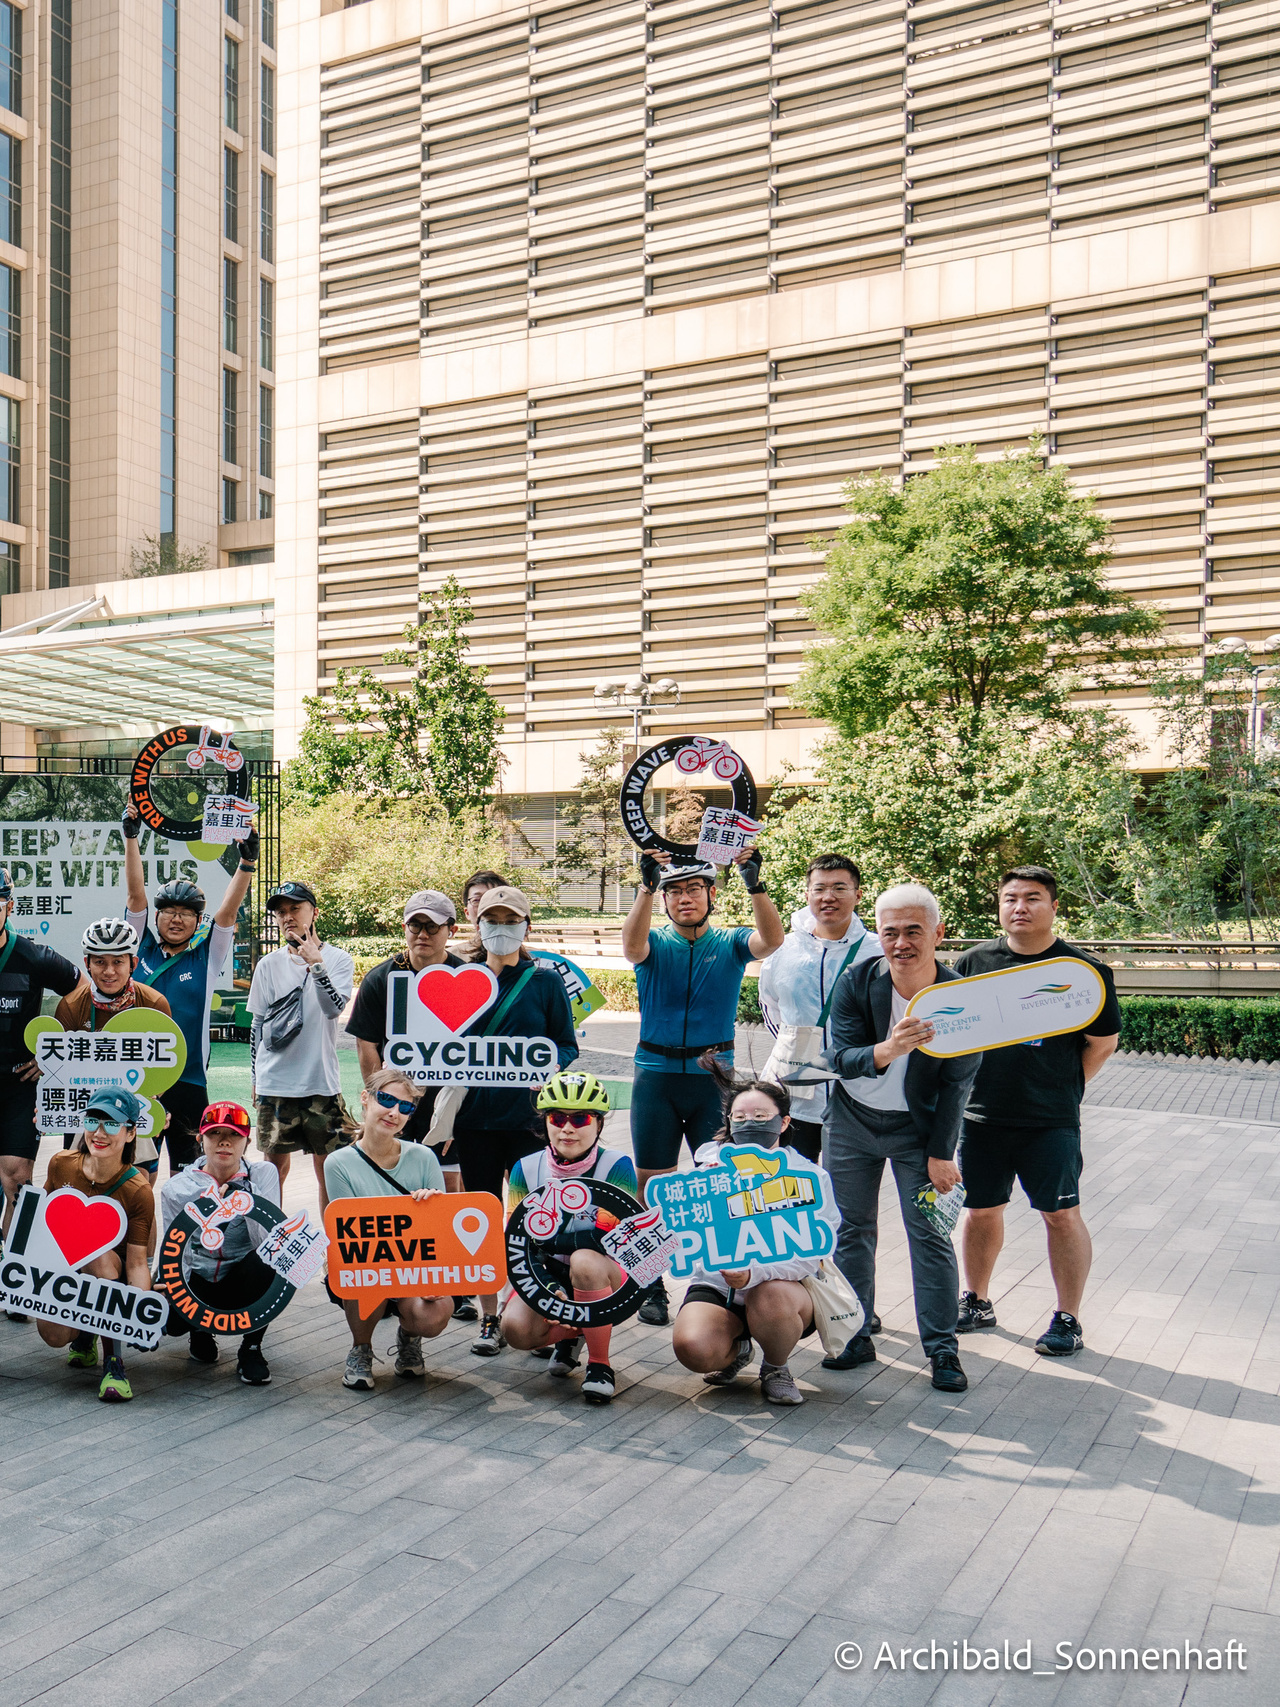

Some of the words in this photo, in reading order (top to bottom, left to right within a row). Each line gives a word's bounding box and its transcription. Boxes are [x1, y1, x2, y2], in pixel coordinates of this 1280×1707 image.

[163, 728, 188, 746] US
[133, 740, 164, 787] WITH
[626, 746, 671, 794] WAVE
[135, 790, 165, 828] RIDE
[207, 797, 236, 811] 天津
[205, 827, 249, 837] RIVERVIEW
[206, 813, 250, 828] 嘉里汇
[626, 799, 654, 843] KEEP
[707, 810, 740, 829] 天津
[204, 834, 230, 842] PLACE
[700, 842, 741, 857] RIVERVIE
[702, 827, 753, 848] 嘉里汇
[699, 850, 728, 862] PLACE
[157, 860, 198, 886] US
[11, 896, 72, 915] 嘉里汇
[179, 971, 192, 982] GRC
[1, 997, 19, 1009] Sport
[392, 977, 408, 1034] I
[1021, 995, 1065, 1011] RIVERVIEW
[1067, 989, 1091, 1001] PLACE
[930, 1021, 950, 1031] ERRY
[951, 1015, 981, 1027] CENTRE
[936, 1024, 971, 1036] 津嘉里中心
[41, 1037, 171, 1062] 天津嘉里汇
[390, 1042, 552, 1067] CYCLING
[452, 1071, 517, 1082] CYCLING
[518, 1072, 550, 1082] DAY
[9, 1191, 41, 1256] I
[668, 1200, 713, 1227] 计划
[336, 1215, 412, 1239] KEEP
[604, 1220, 641, 1254] 天津
[163, 1228, 186, 1257] US
[260, 1227, 291, 1261] 天津
[274, 1224, 320, 1274] 嘉里汇
[338, 1238, 436, 1264] WAVE
[619, 1223, 672, 1270] 嘉里汇
[288, 1236, 327, 1279] RIVERVIEW
[509, 1234, 539, 1299] WAVE
[632, 1238, 679, 1278] RIVERVIEW
[293, 1258, 320, 1286] PLACE
[339, 1268, 392, 1287] RIDE
[395, 1266, 460, 1285] WITH
[464, 1264, 496, 1283] US
[639, 1260, 669, 1285] PLACE
[1, 1262, 163, 1325] CYCLING
[163, 1263, 199, 1319] WITH
[200, 1309, 251, 1331] RIDE
[538, 1297, 590, 1322] KEEP
[60, 1309, 122, 1333] CYCLING
[124, 1325, 155, 1341] DAY
